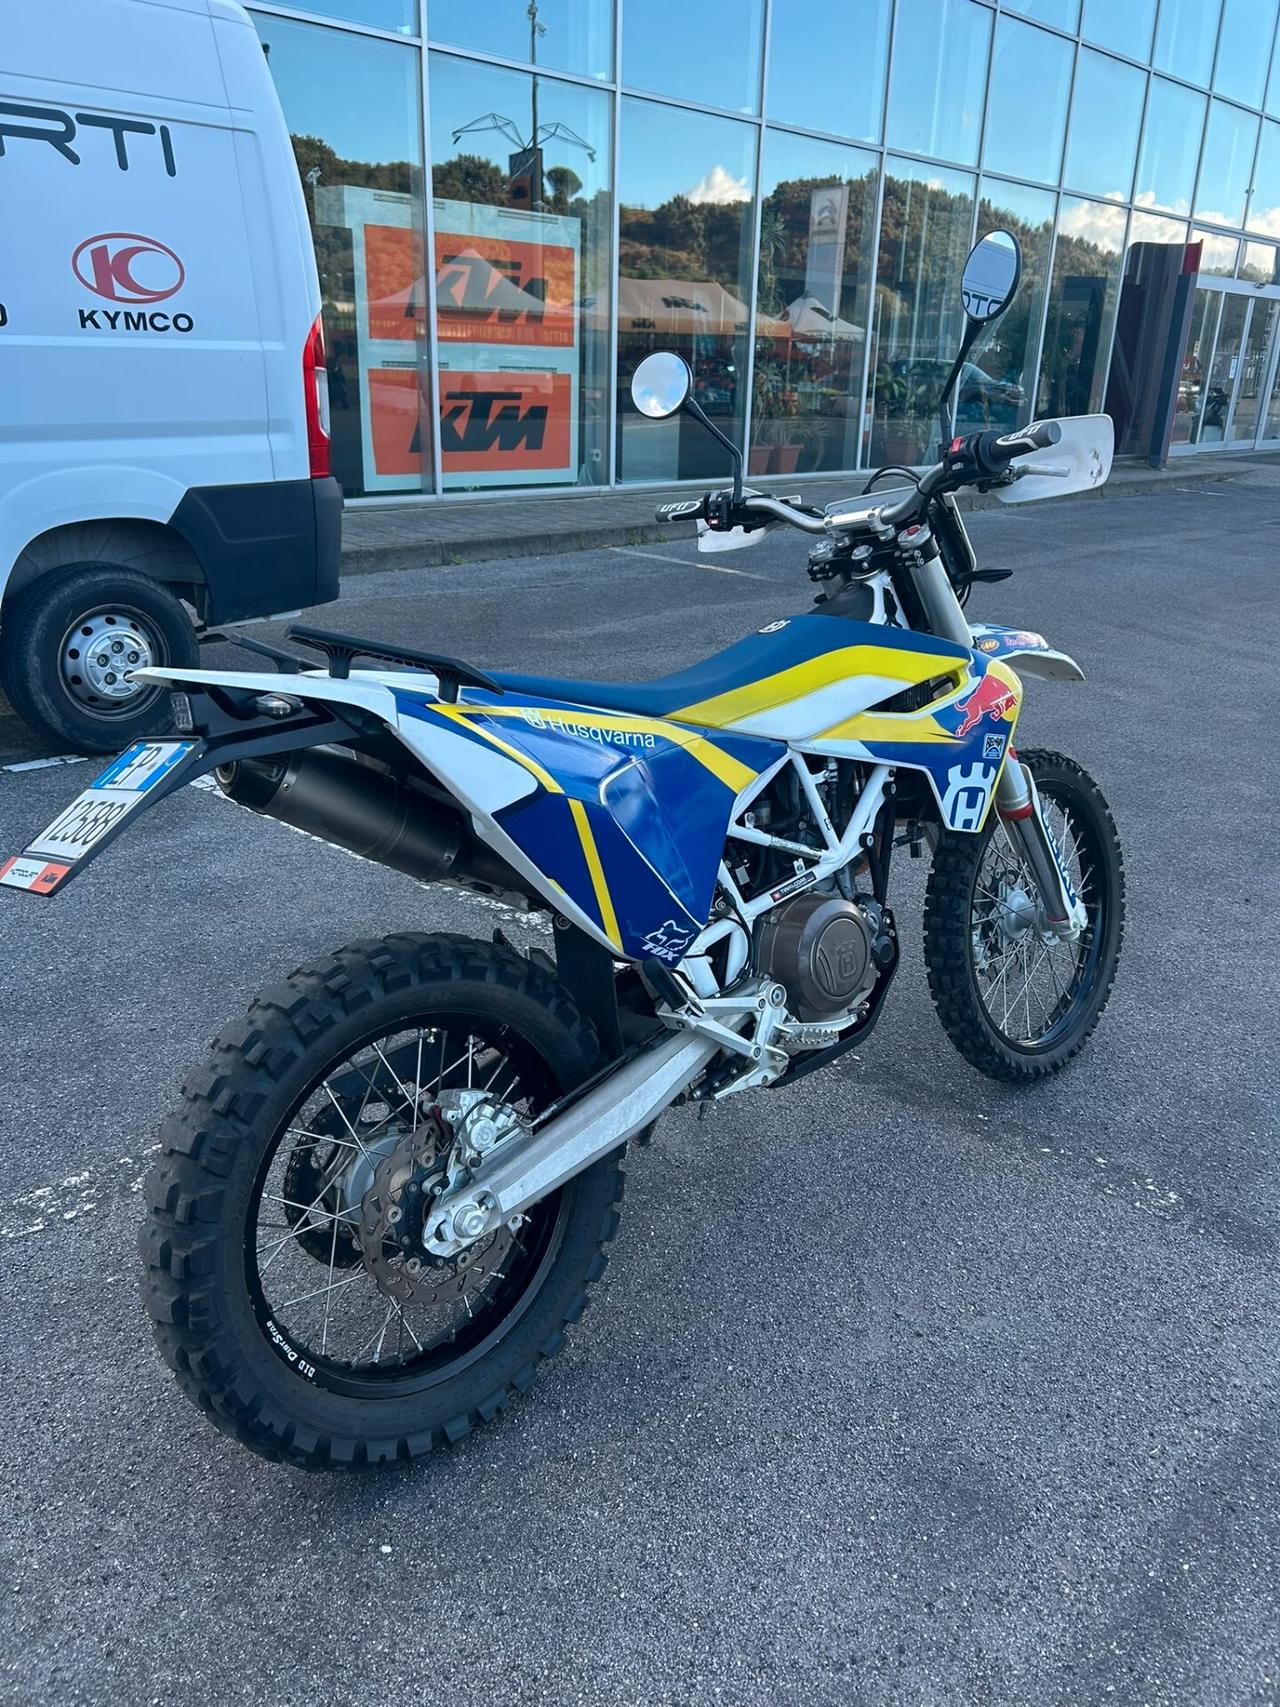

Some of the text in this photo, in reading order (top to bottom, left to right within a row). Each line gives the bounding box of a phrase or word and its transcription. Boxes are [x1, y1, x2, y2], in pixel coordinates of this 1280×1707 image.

[404, 255, 548, 324] KTM
[78, 309, 194, 332] KYMCO
[409, 392, 548, 453] KTM
[547, 715, 656, 748] Husqvarna
[108, 746, 162, 786] EP
[43, 800, 127, 846] 12588
[641, 942, 680, 961] FOX
